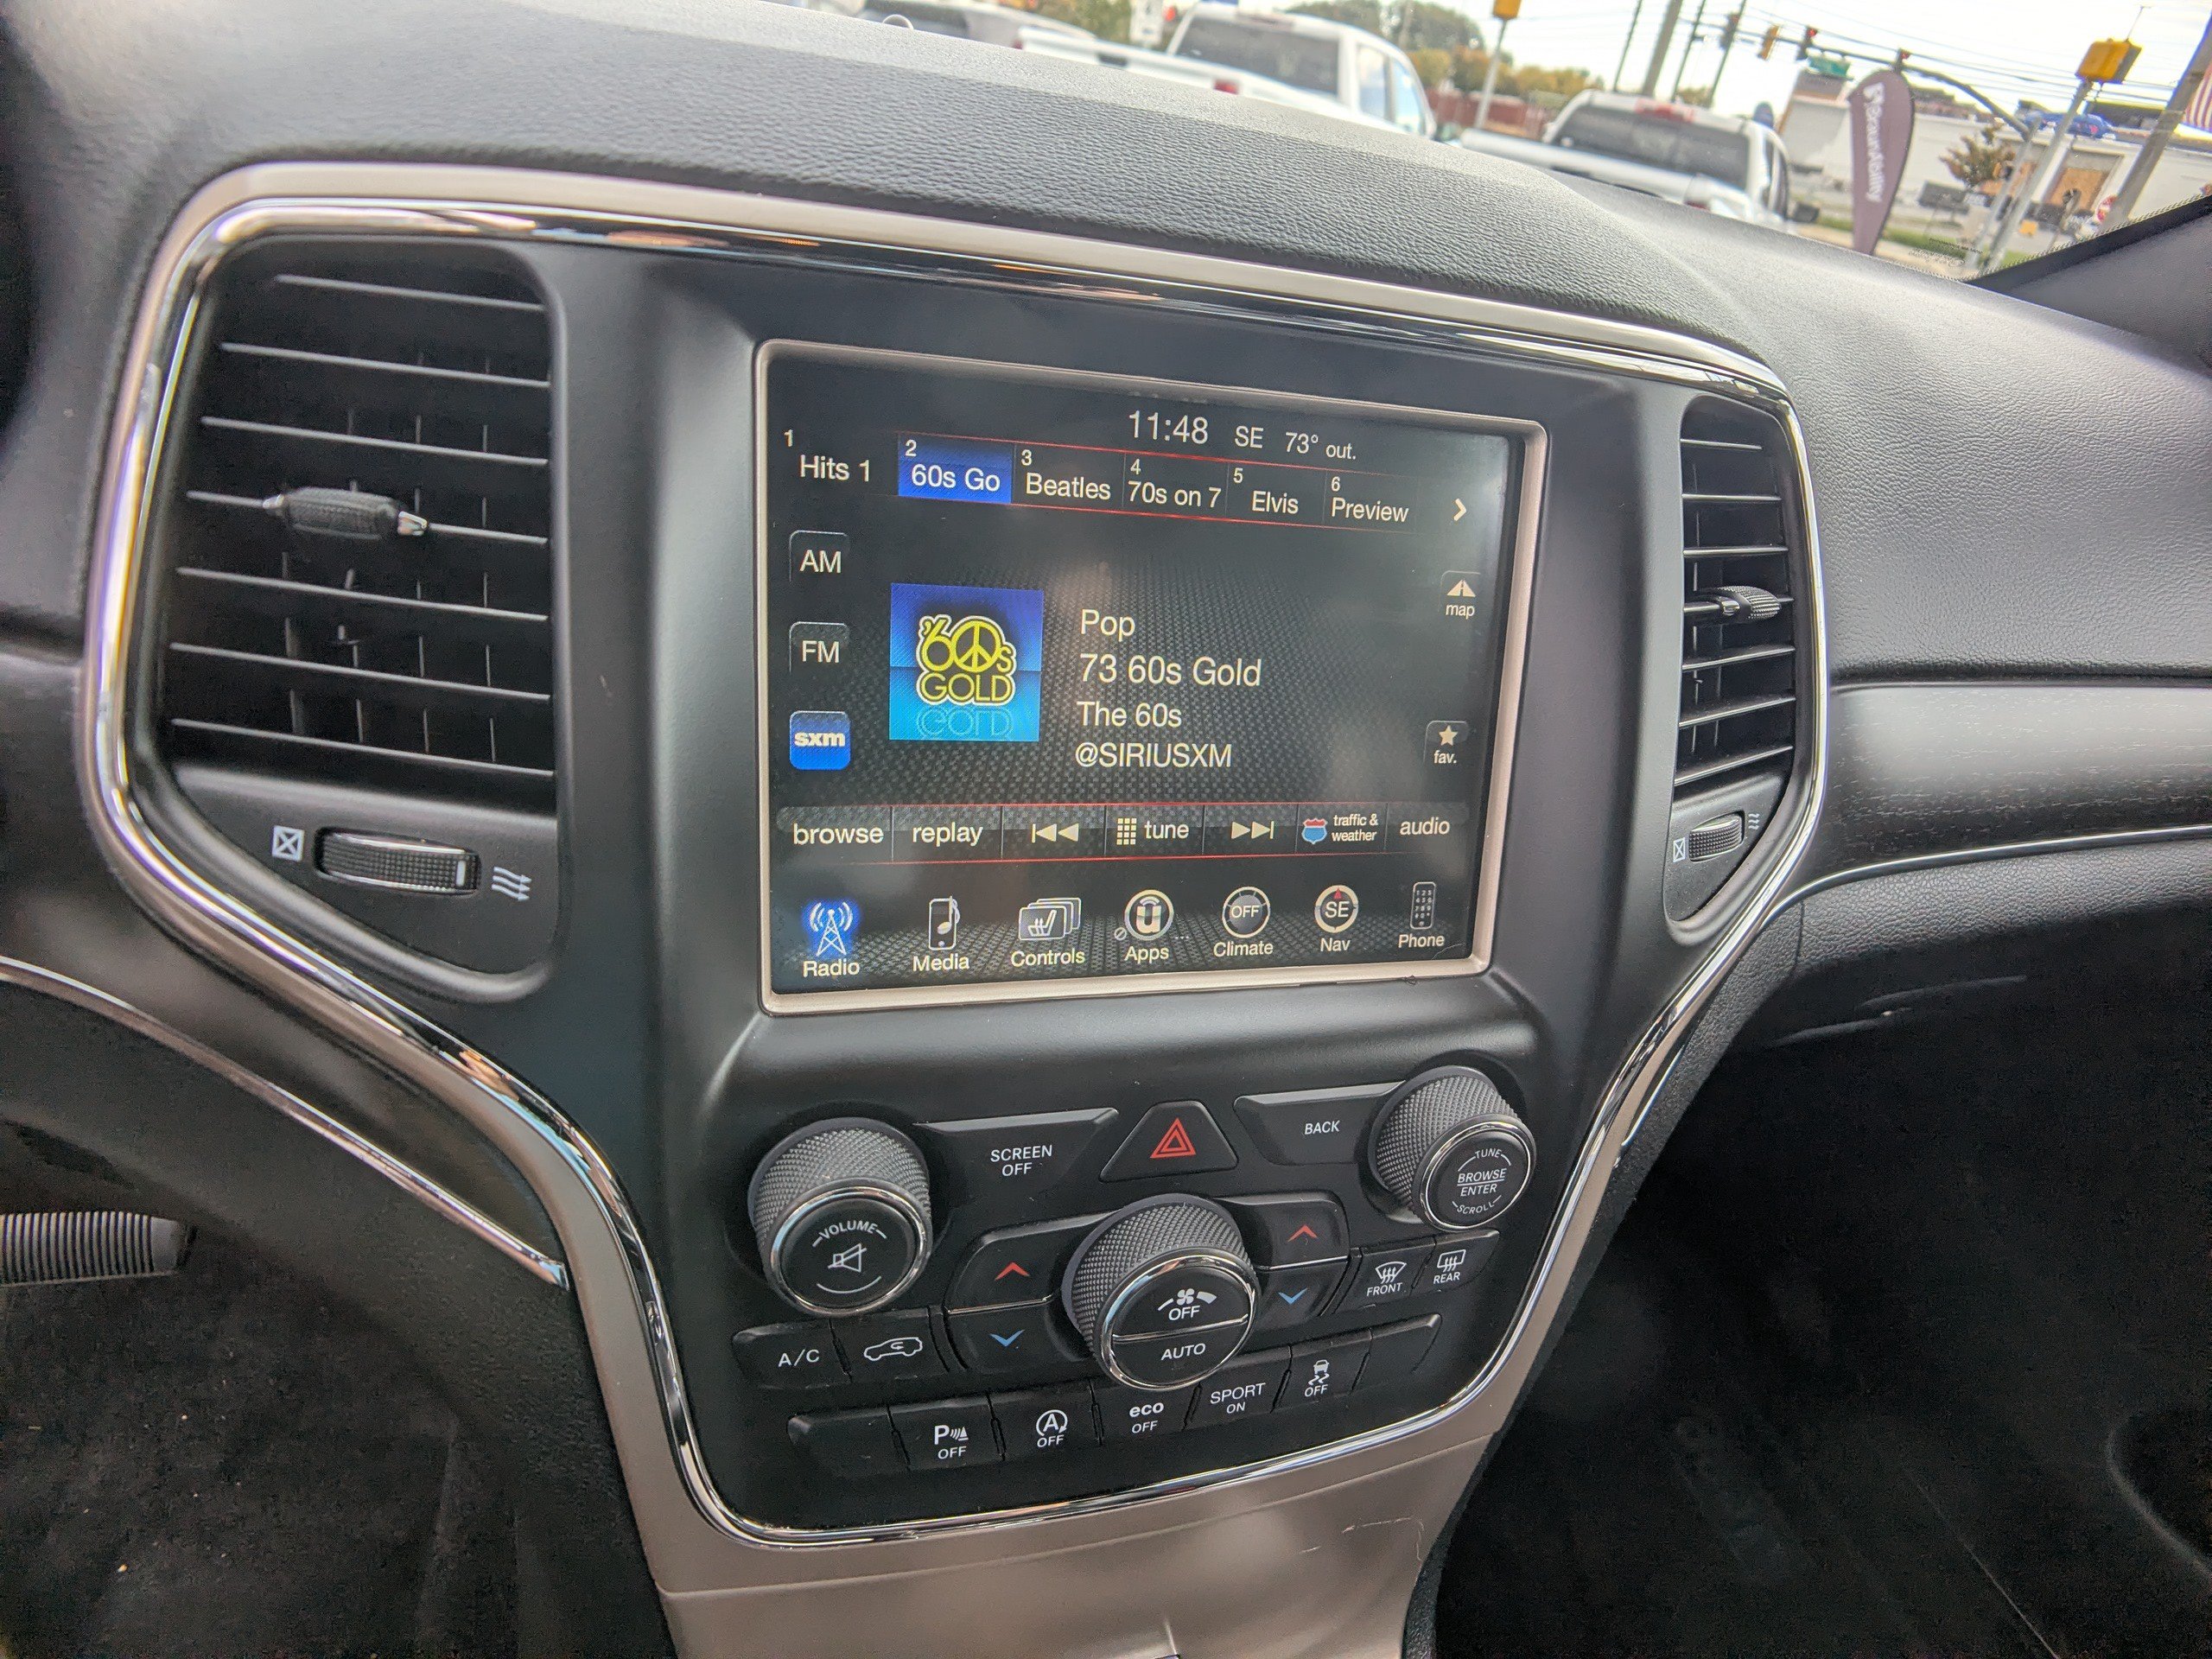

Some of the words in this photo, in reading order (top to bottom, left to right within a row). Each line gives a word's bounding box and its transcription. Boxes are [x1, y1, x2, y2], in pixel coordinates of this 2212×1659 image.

[785, 429, 793, 447] 1
[1128, 410, 1209, 445] 11:48
[1234, 425, 1264, 448] SE
[1325, 441, 1357, 461] out.
[905, 441, 917, 457] 2
[1021, 449, 1033, 467] 3
[799, 454, 849, 480] Hits
[860, 460, 870, 482] 1
[1130, 459, 1141, 475] 4
[1233, 467, 1243, 484] 5
[912, 465, 956, 489] 60s
[965, 467, 1001, 493] Go
[1026, 473, 1111, 500] Beatles
[1331, 476, 1341, 493] 6
[1128, 480, 1167, 505] 70s
[1174, 487, 1202, 507] on
[1208, 486, 1222, 508] 7
[1251, 490, 1299, 514] Elvis
[1332, 497, 1409, 523] Preview
[799, 550, 842, 574] AM
[1445, 603, 1475, 619] map
[1080, 608, 1136, 642] Pop
[802, 640, 840, 663] FM
[1080, 653, 1117, 683] 73
[1128, 655, 1182, 684] 60s
[1192, 657, 1262, 686] Gold
[920, 672, 1014, 702] GOLD
[1077, 701, 1127, 727] The
[1135, 702, 1182, 728] 60s
[794, 732, 846, 747] sxm
[1075, 741, 1232, 768] @SIRIUSXM
[1434, 750, 1458, 765] fav.
[1144, 816, 1189, 839] tune
[1333, 814, 1369, 827] traffic
[1370, 814, 1378, 826] &
[1400, 817, 1450, 836] audio
[793, 823, 884, 845] browse
[912, 823, 983, 847] replay
[1332, 829, 1376, 842] weather
[1230, 904, 1259, 919] OFF
[1325, 901, 1350, 918] SE
[1214, 940, 1274, 958] Climate
[1320, 938, 1351, 952] Nav
[1398, 933, 1445, 950] Phone
[912, 954, 969, 972] Media
[1011, 948, 1085, 967] Controls
[1124, 945, 1169, 964] Apps
[803, 960, 860, 977] Radio
[1304, 1120, 1340, 1136] BACK
[989, 1144, 1053, 1163] SCREEN
[1475, 1147, 1502, 1160] TUNE
[1001, 1162, 1033, 1177] OFF
[1458, 1167, 1507, 1183] BROWSE
[1459, 1182, 1497, 1197] ENTER
[1457, 1201, 1496, 1215] SCROLL
[818, 1219, 878, 1241] VOLUME
[1433, 1270, 1461, 1284] REAR
[1366, 1281, 1403, 1296] FRONT
[1168, 1305, 1200, 1321] OFF
[778, 1349, 820, 1368] A/C
[1160, 1342, 1206, 1361] AUTO
[1210, 1382, 1266, 1404] SPORT
[1304, 1383, 1328, 1398] OFF
[1128, 1401, 1165, 1419] eco
[1226, 1401, 1246, 1414] ON
[1131, 1420, 1159, 1434] OFF
[1037, 1433, 1065, 1448] OFF
[938, 1446, 967, 1460] OFF
